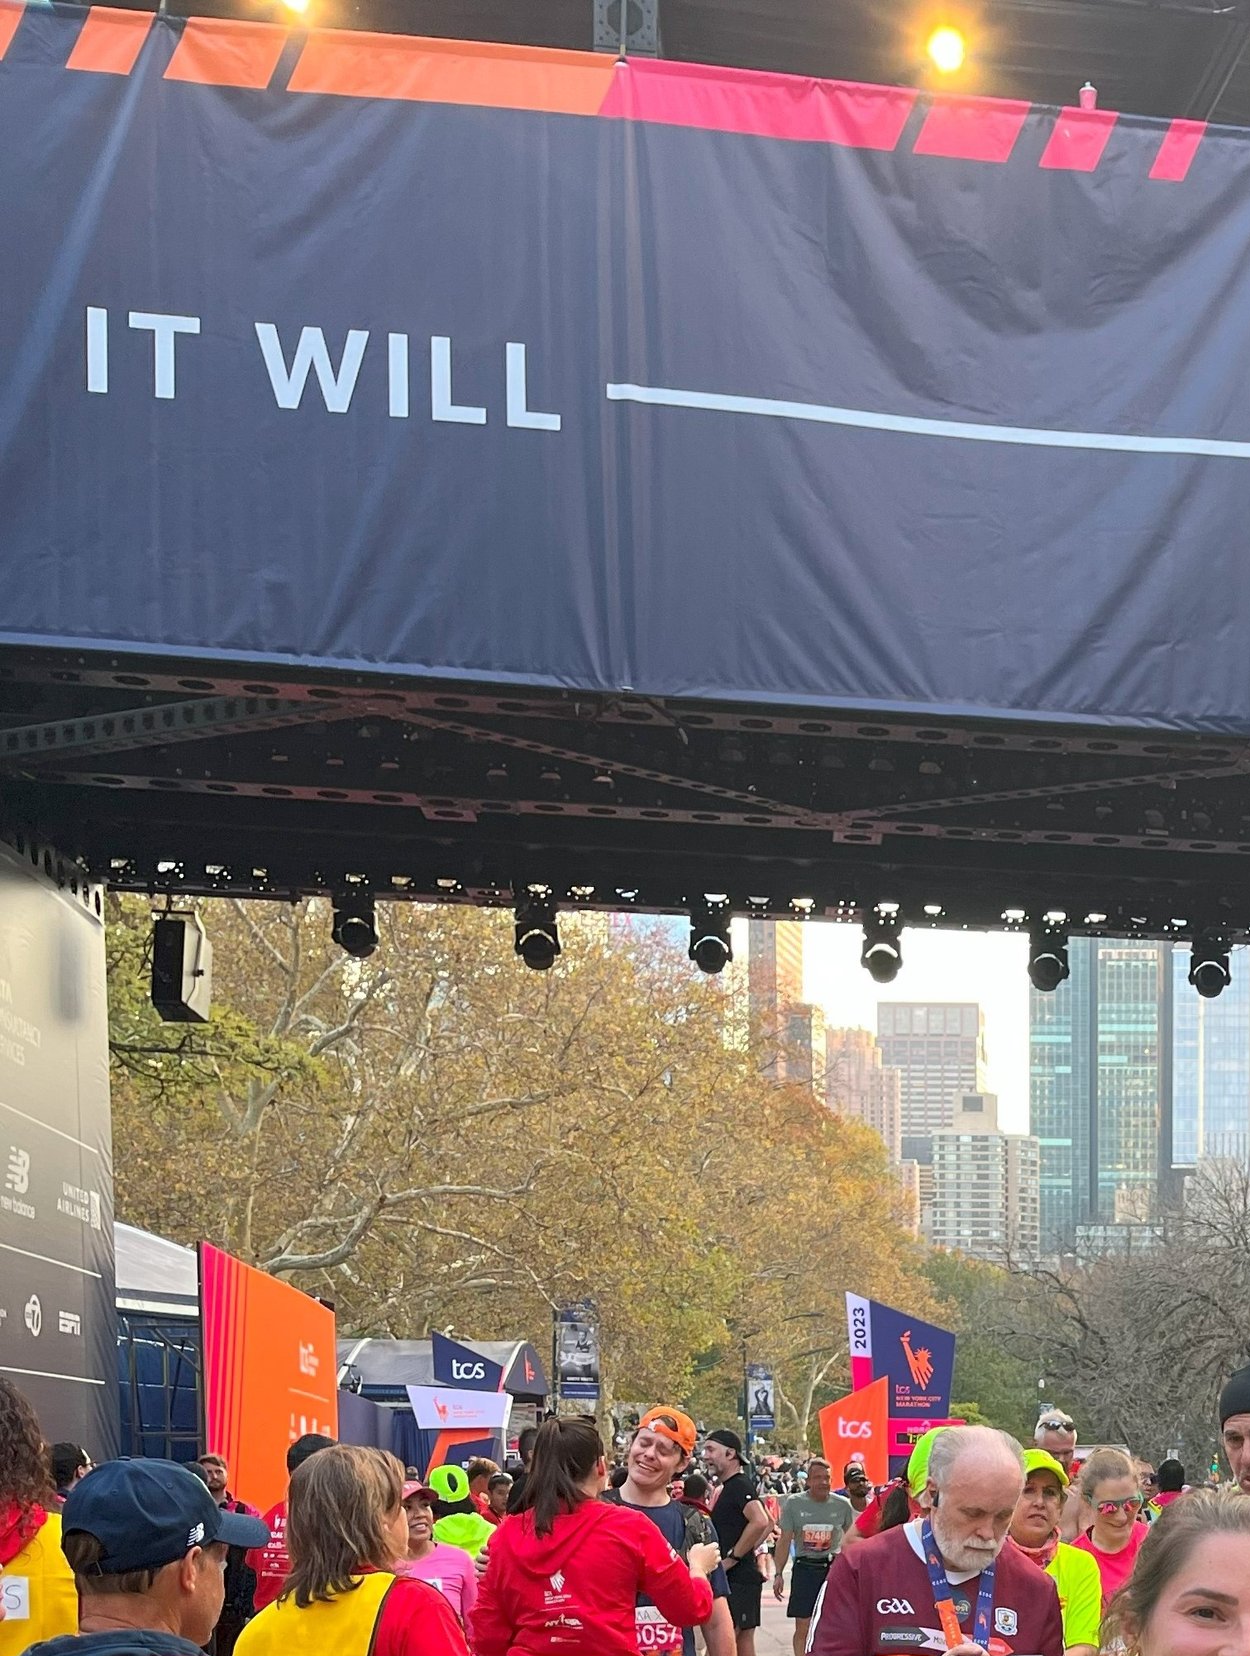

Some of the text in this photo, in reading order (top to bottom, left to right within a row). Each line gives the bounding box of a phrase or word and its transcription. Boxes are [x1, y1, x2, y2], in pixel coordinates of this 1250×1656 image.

[86, 306, 562, 431] IT WILL
[62, 1181, 90, 1205] UNITED
[57, 1198, 90, 1224] AIRLINES
[59, 1310, 81, 1336] ESPN
[853, 1306, 867, 1349] 2023
[452, 1359, 486, 1380] tcs
[895, 1384, 911, 1394] tcs
[838, 1416, 873, 1438] tcs
[877, 1598, 915, 1615] GAA
[880, 1631, 923, 1643] PROGRESSIVE
